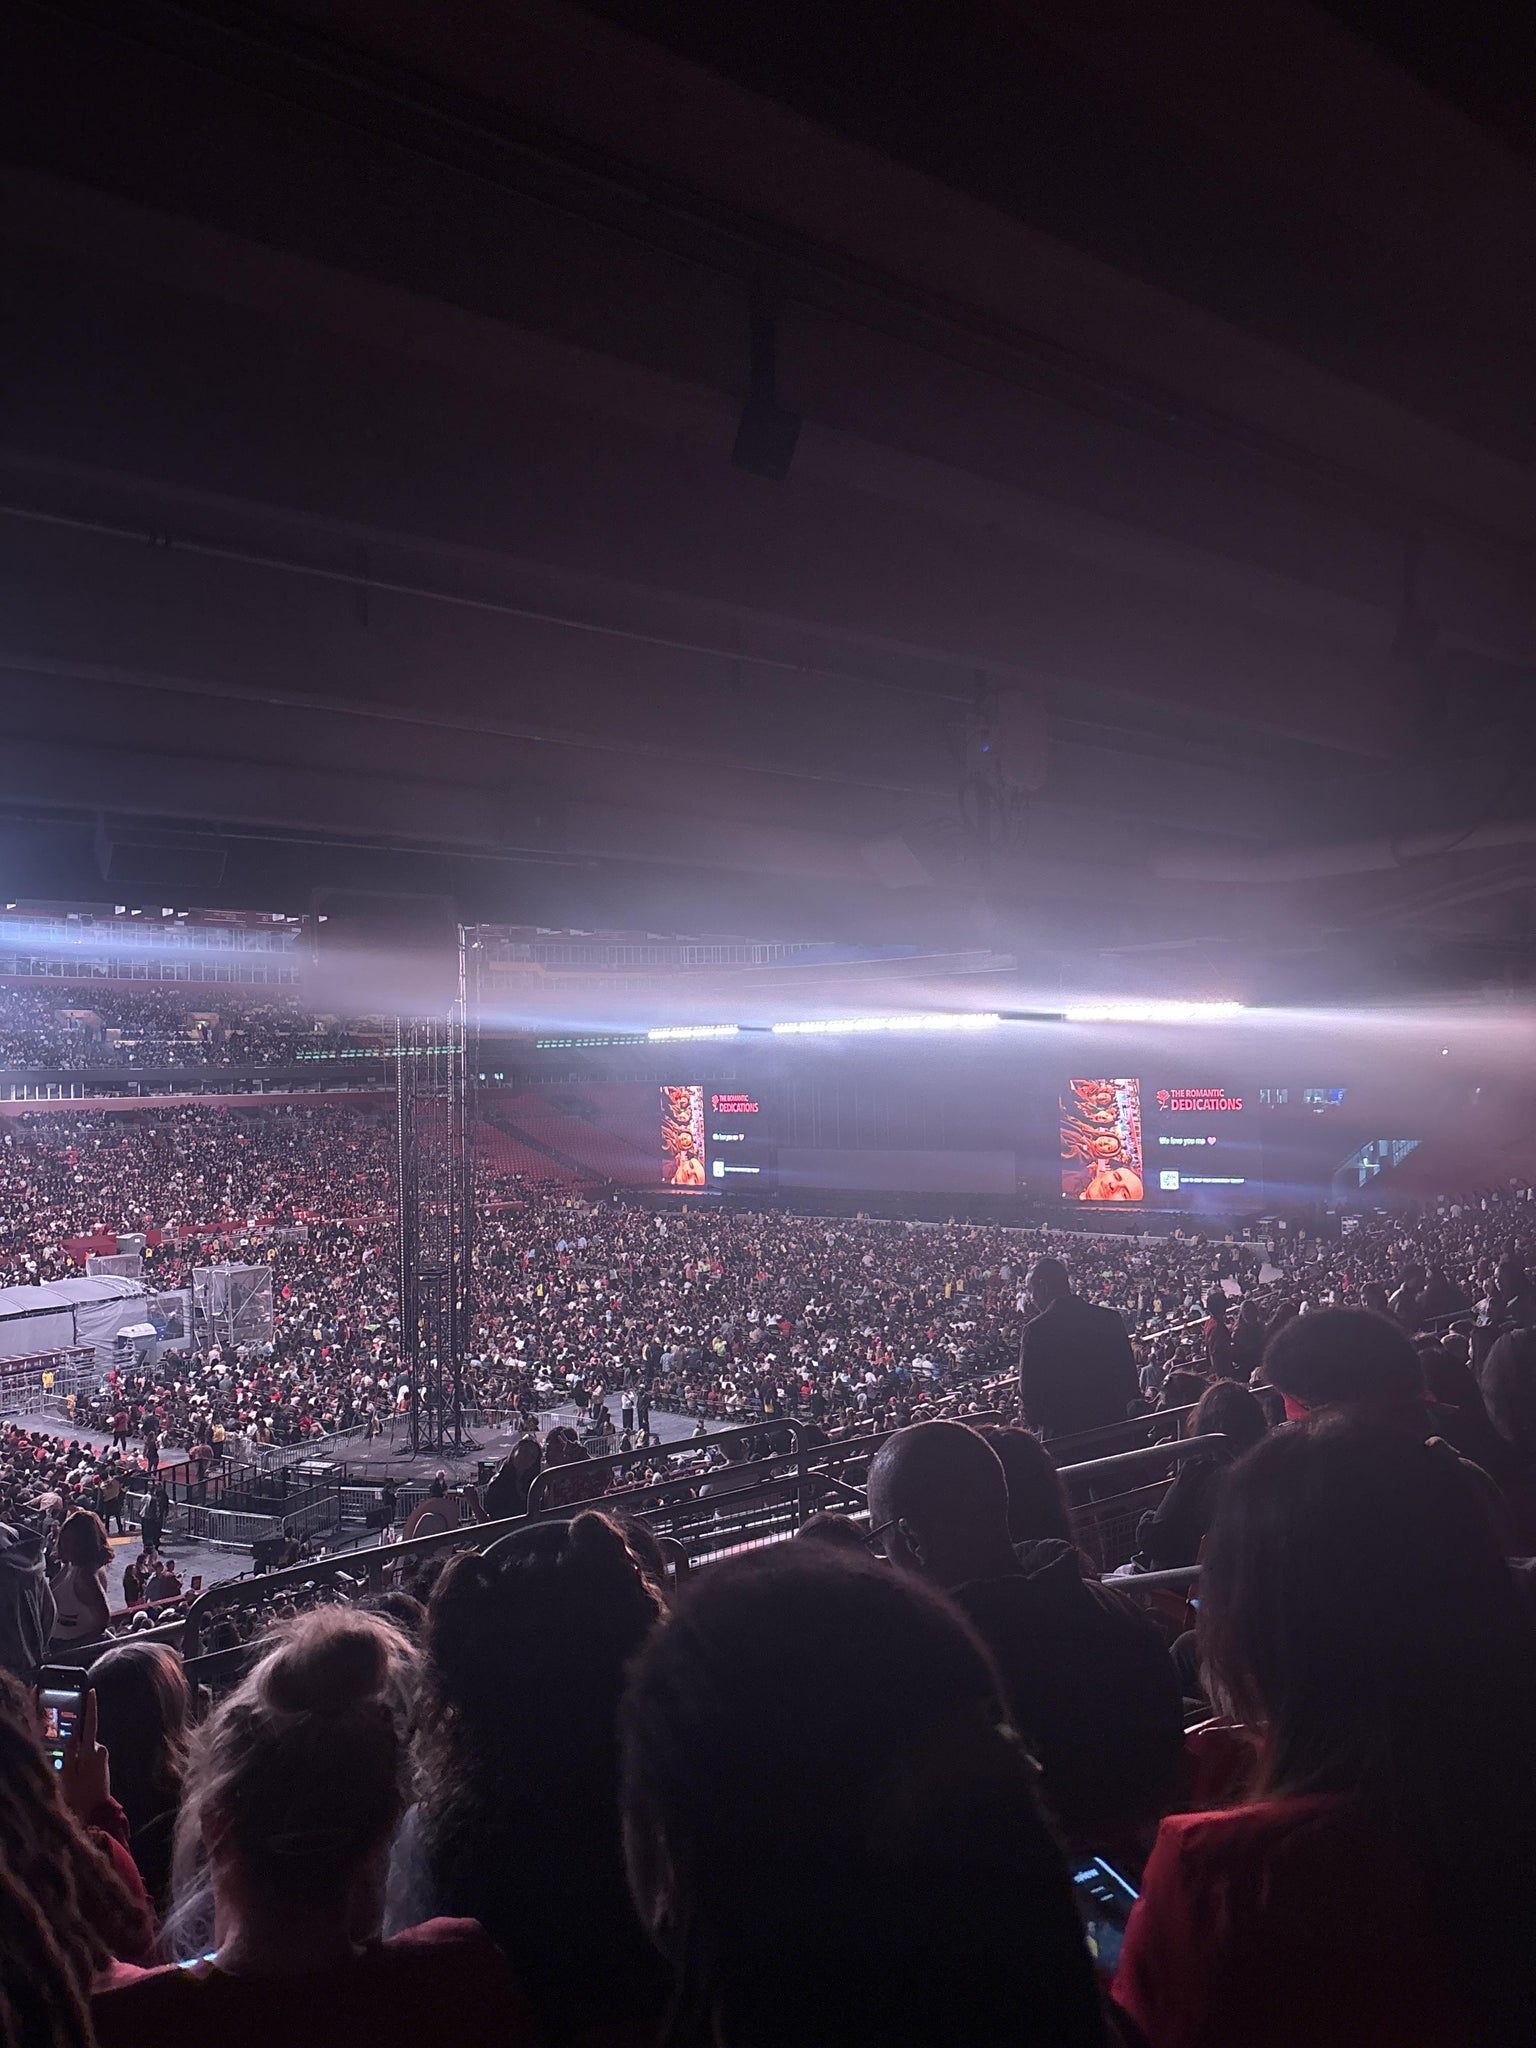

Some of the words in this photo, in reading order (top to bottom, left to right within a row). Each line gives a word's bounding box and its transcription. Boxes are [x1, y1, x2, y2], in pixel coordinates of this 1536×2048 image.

[1171, 1089, 1185, 1098] THE
[1186, 1088, 1225, 1098] ROMANTIC
[719, 1102, 759, 1113] DEDICATIONS
[1171, 1098, 1243, 1111] DEDICATIONS
